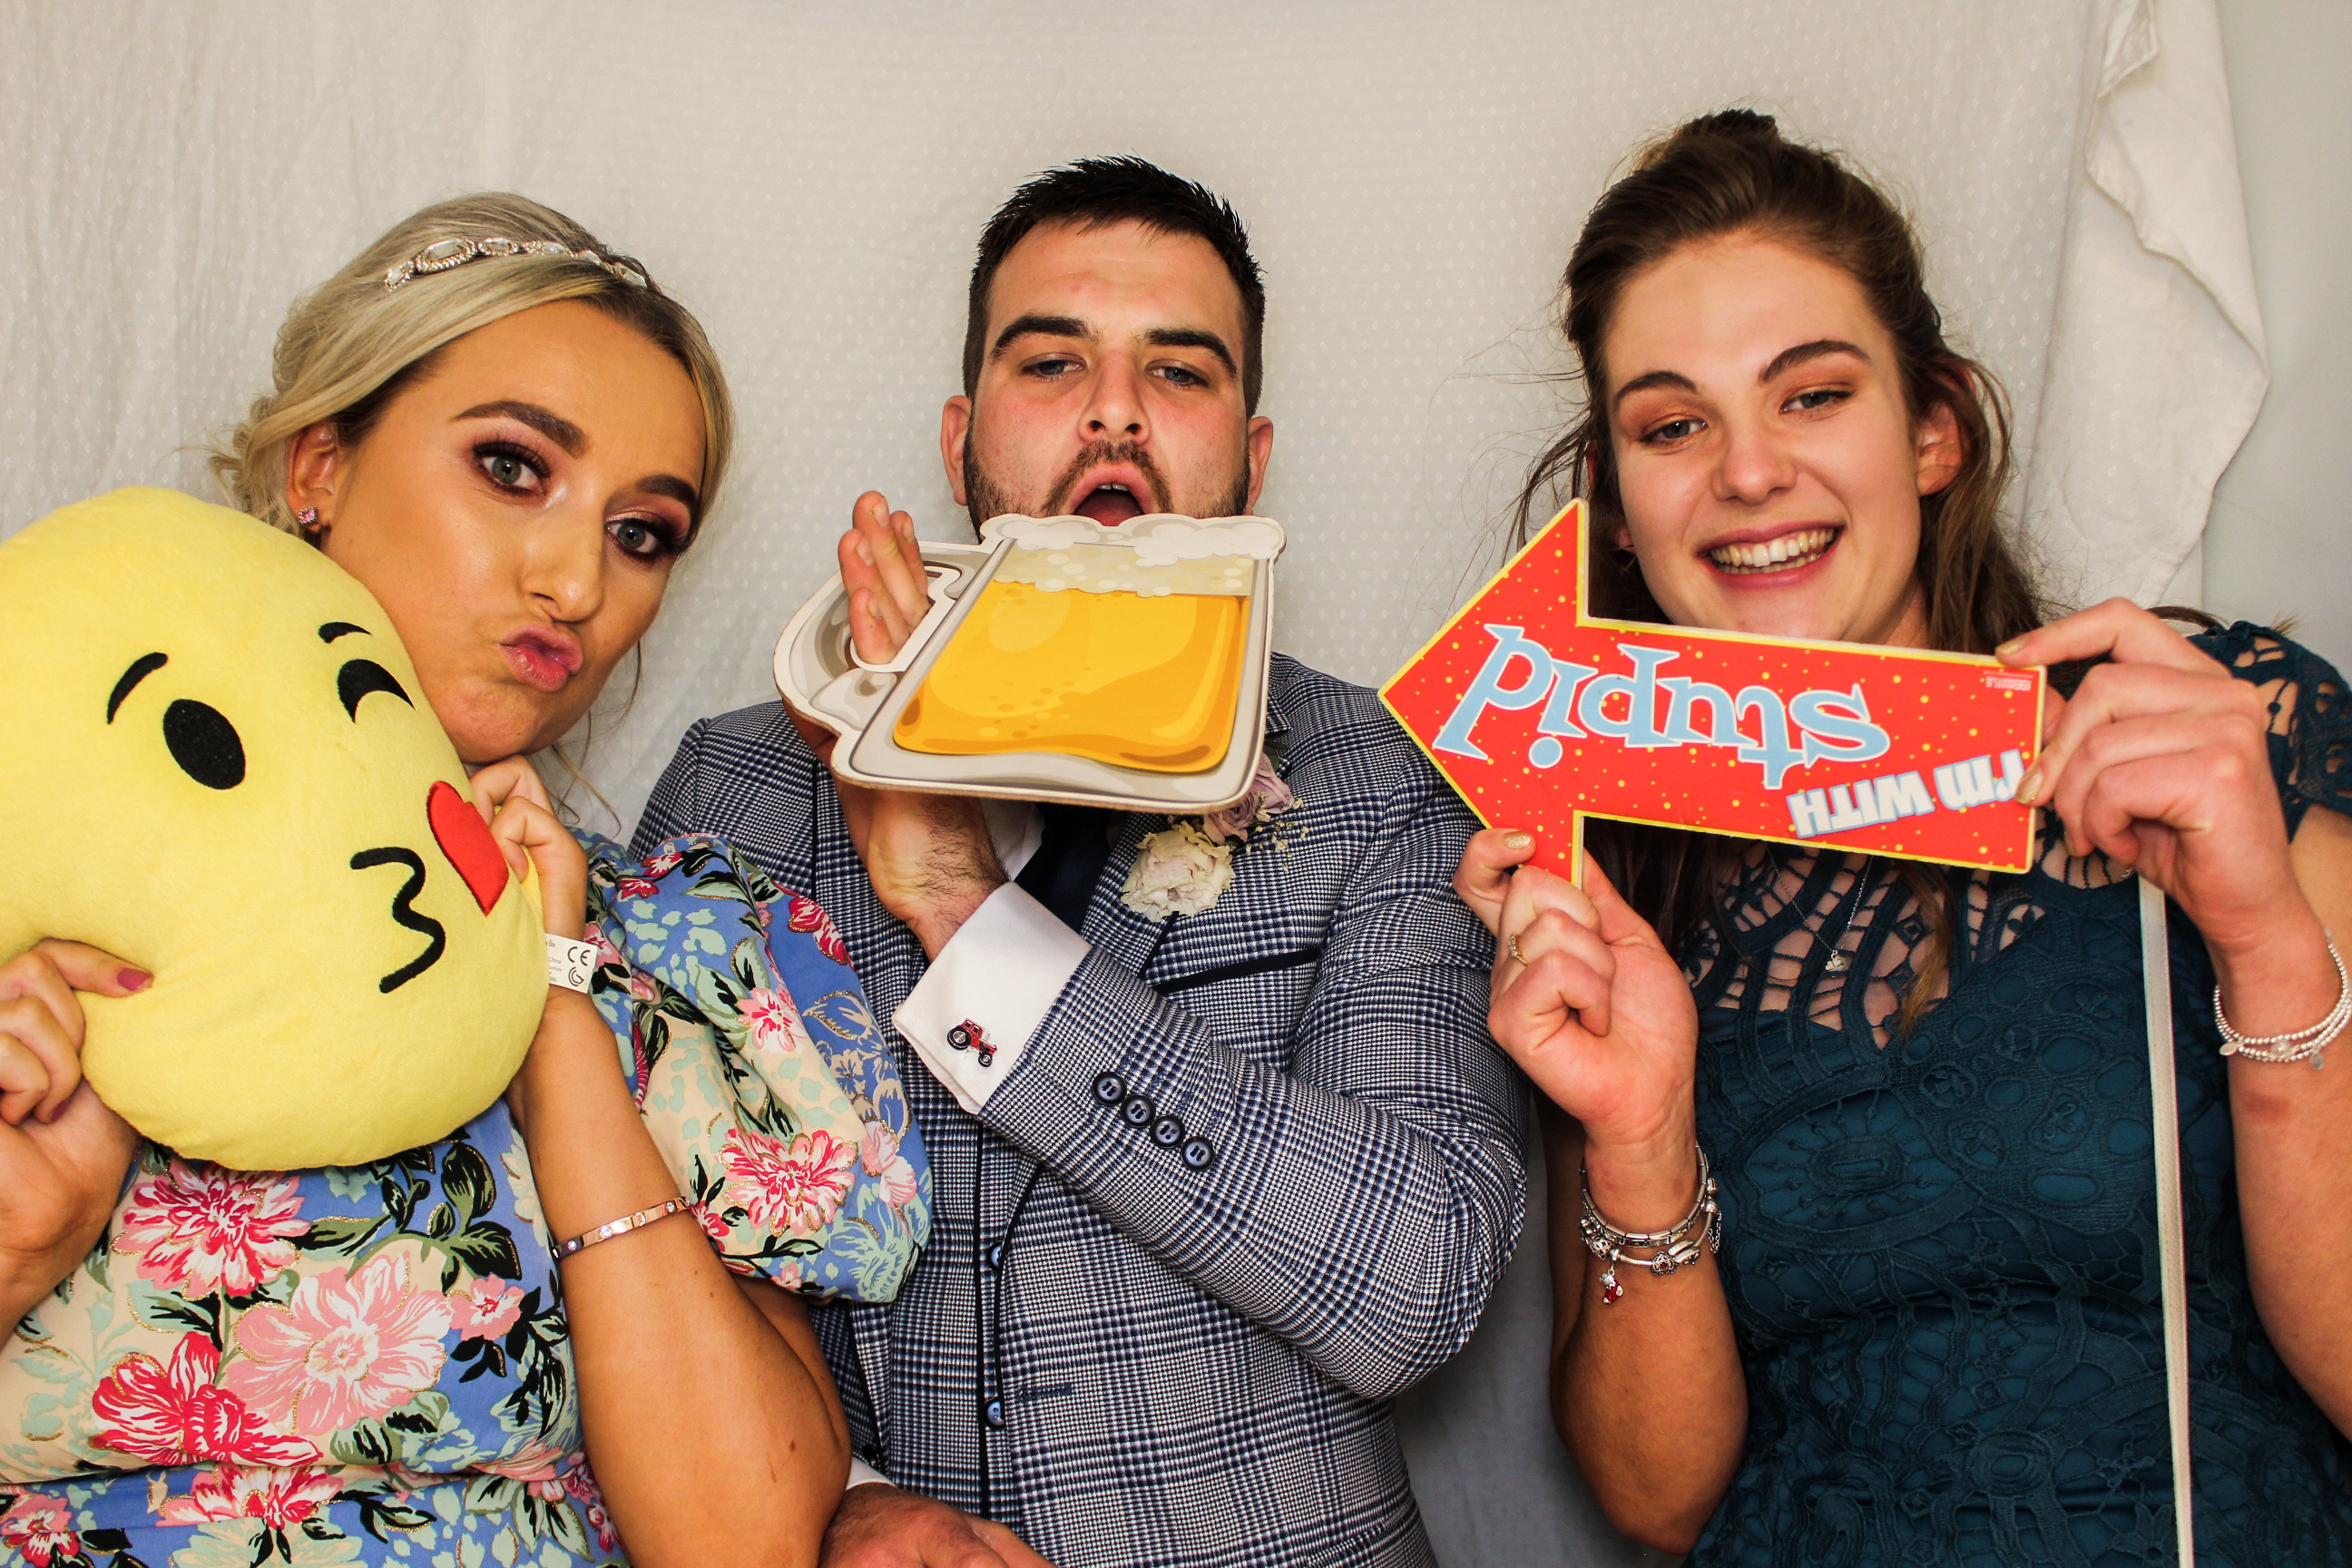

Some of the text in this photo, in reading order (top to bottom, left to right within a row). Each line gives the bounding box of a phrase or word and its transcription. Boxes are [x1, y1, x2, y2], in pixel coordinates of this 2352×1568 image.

[1433, 622, 1891, 789] stupid
[1787, 770, 1936, 838] WITH
[567, 946, 591, 966] CE
